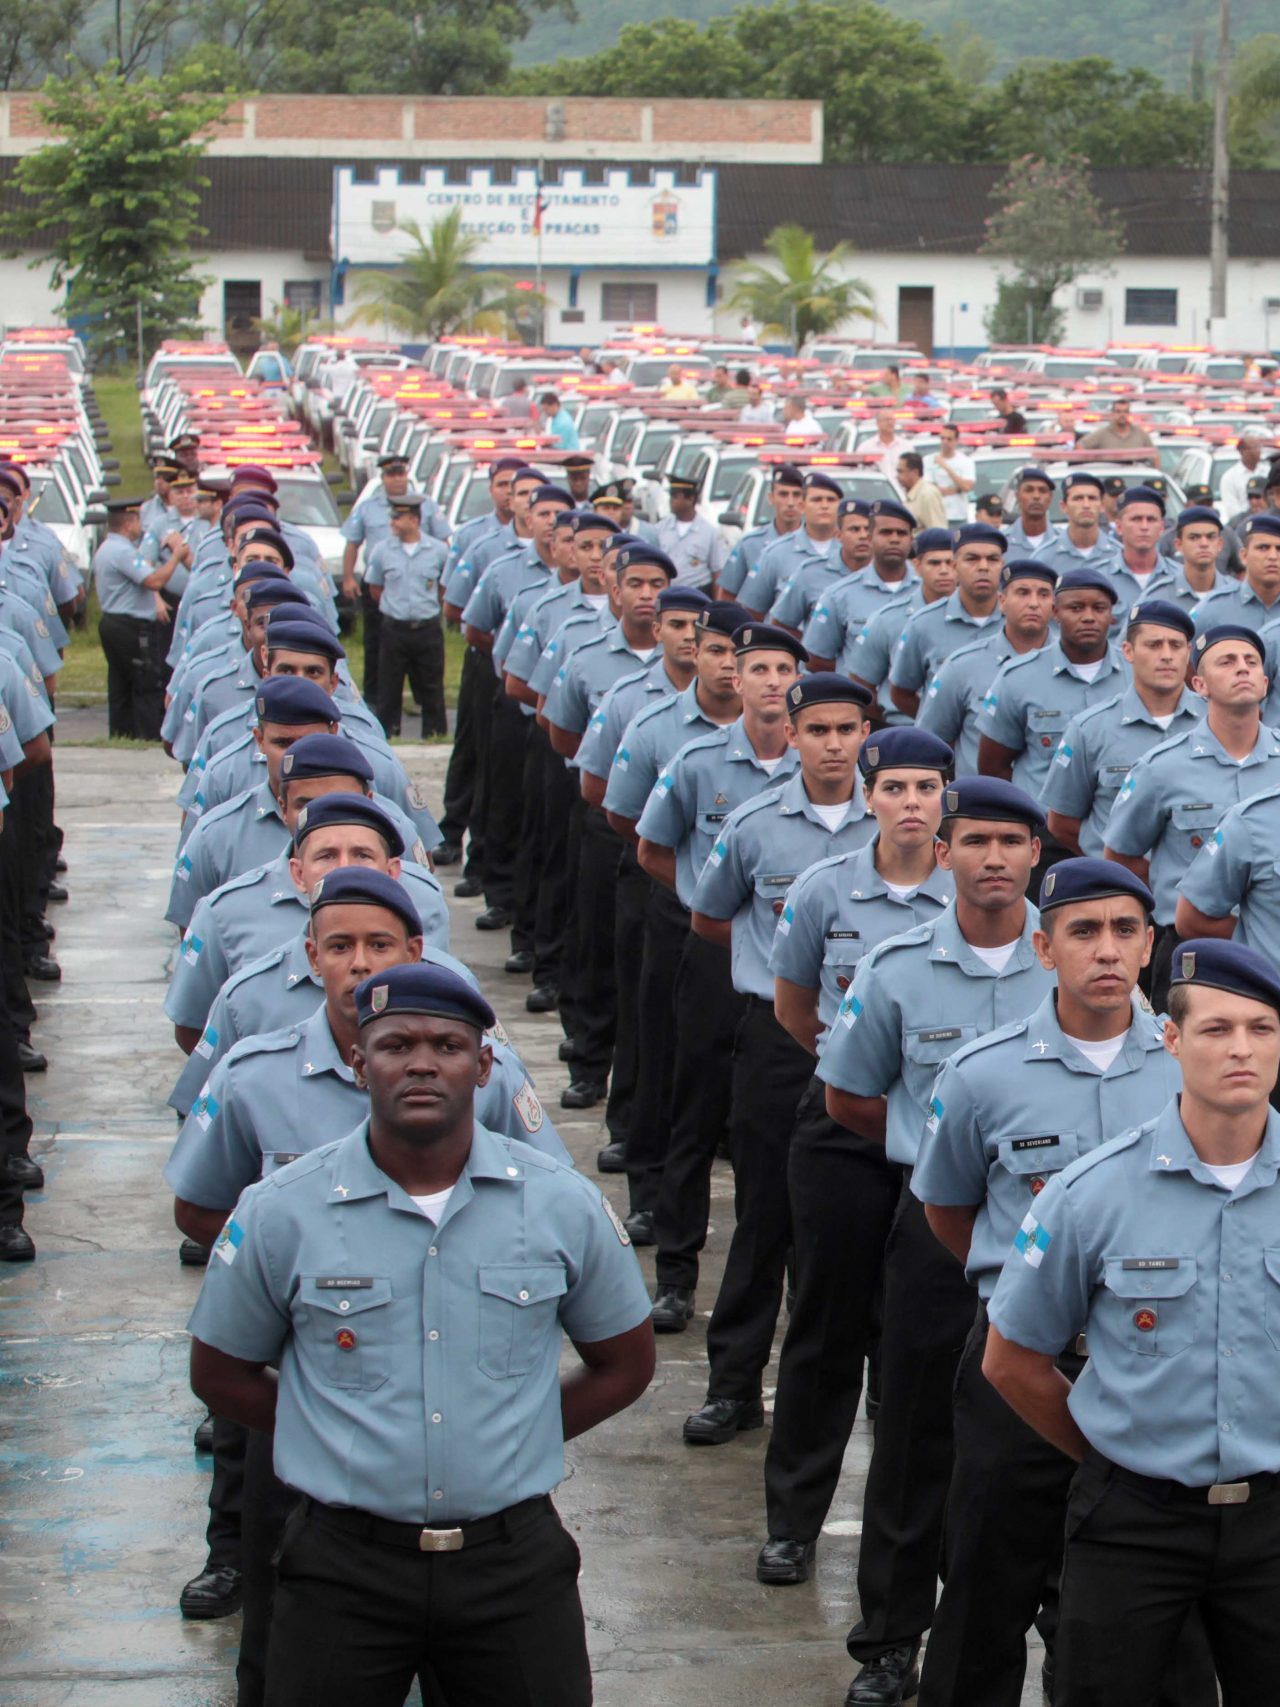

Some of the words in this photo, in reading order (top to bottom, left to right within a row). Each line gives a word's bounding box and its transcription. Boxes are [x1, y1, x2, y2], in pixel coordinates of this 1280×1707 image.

[427, 193, 482, 206] CENTRO
[486, 193, 503, 206] DE
[521, 207, 529, 220] E
[459, 221, 516, 236] ELEÇÃO
